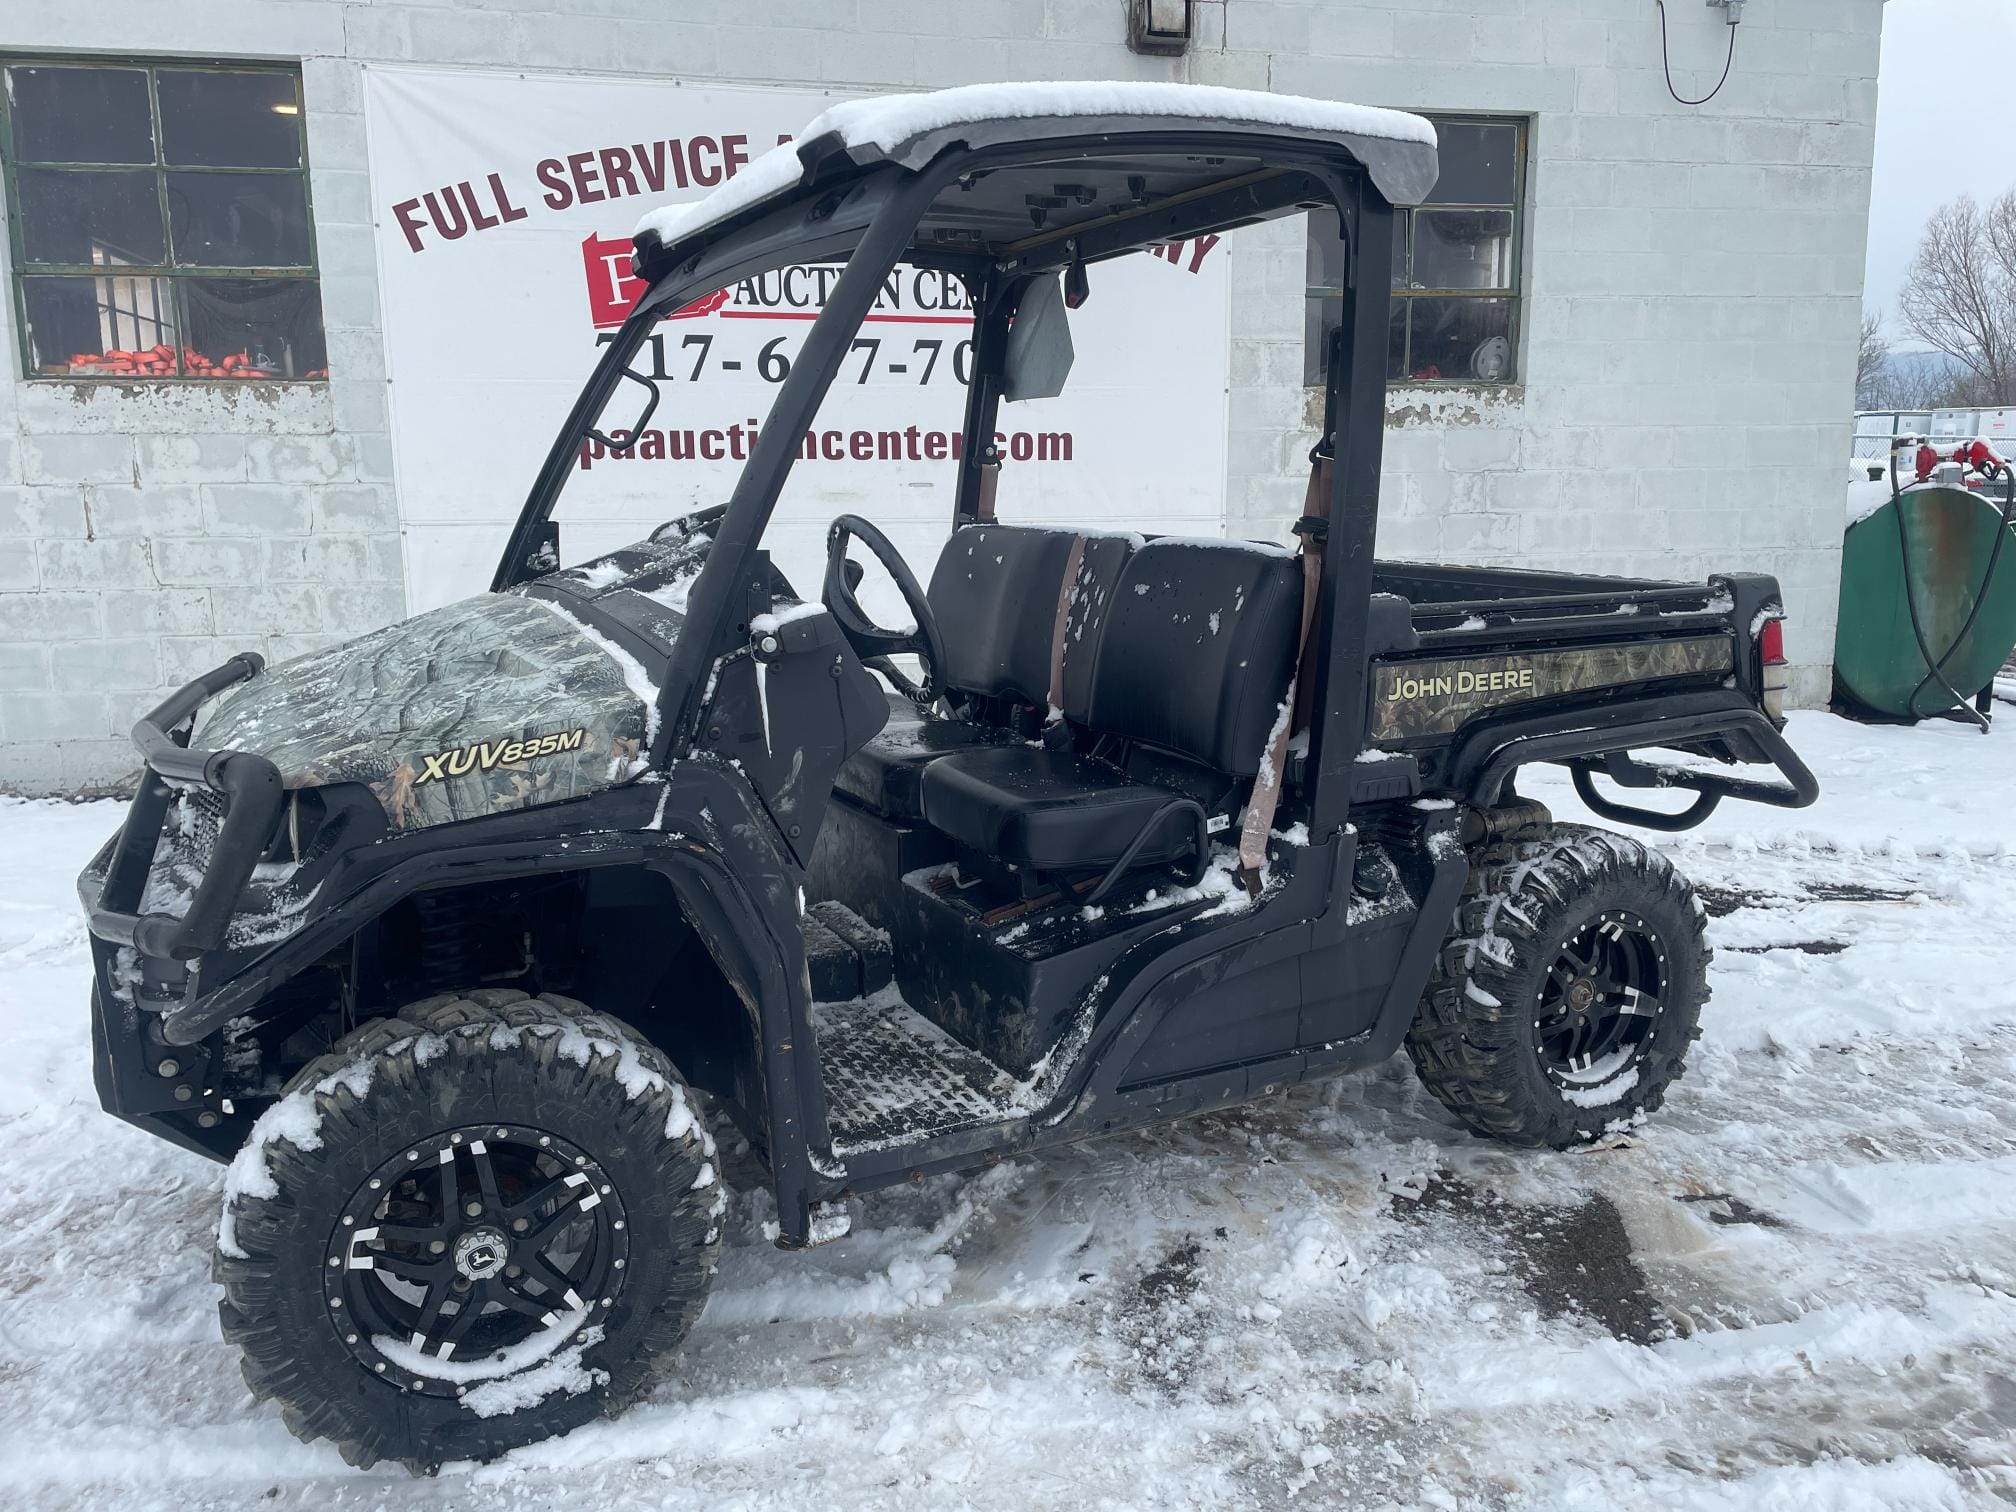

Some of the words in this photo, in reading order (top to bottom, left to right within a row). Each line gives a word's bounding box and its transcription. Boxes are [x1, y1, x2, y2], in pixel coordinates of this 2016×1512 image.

[392, 172, 529, 253] FULL
[536, 134, 750, 211] SERVICE
[733, 265, 902, 310] AUCTN
[1387, 676, 1453, 701] JOHN
[1457, 668, 1534, 694] DEERE
